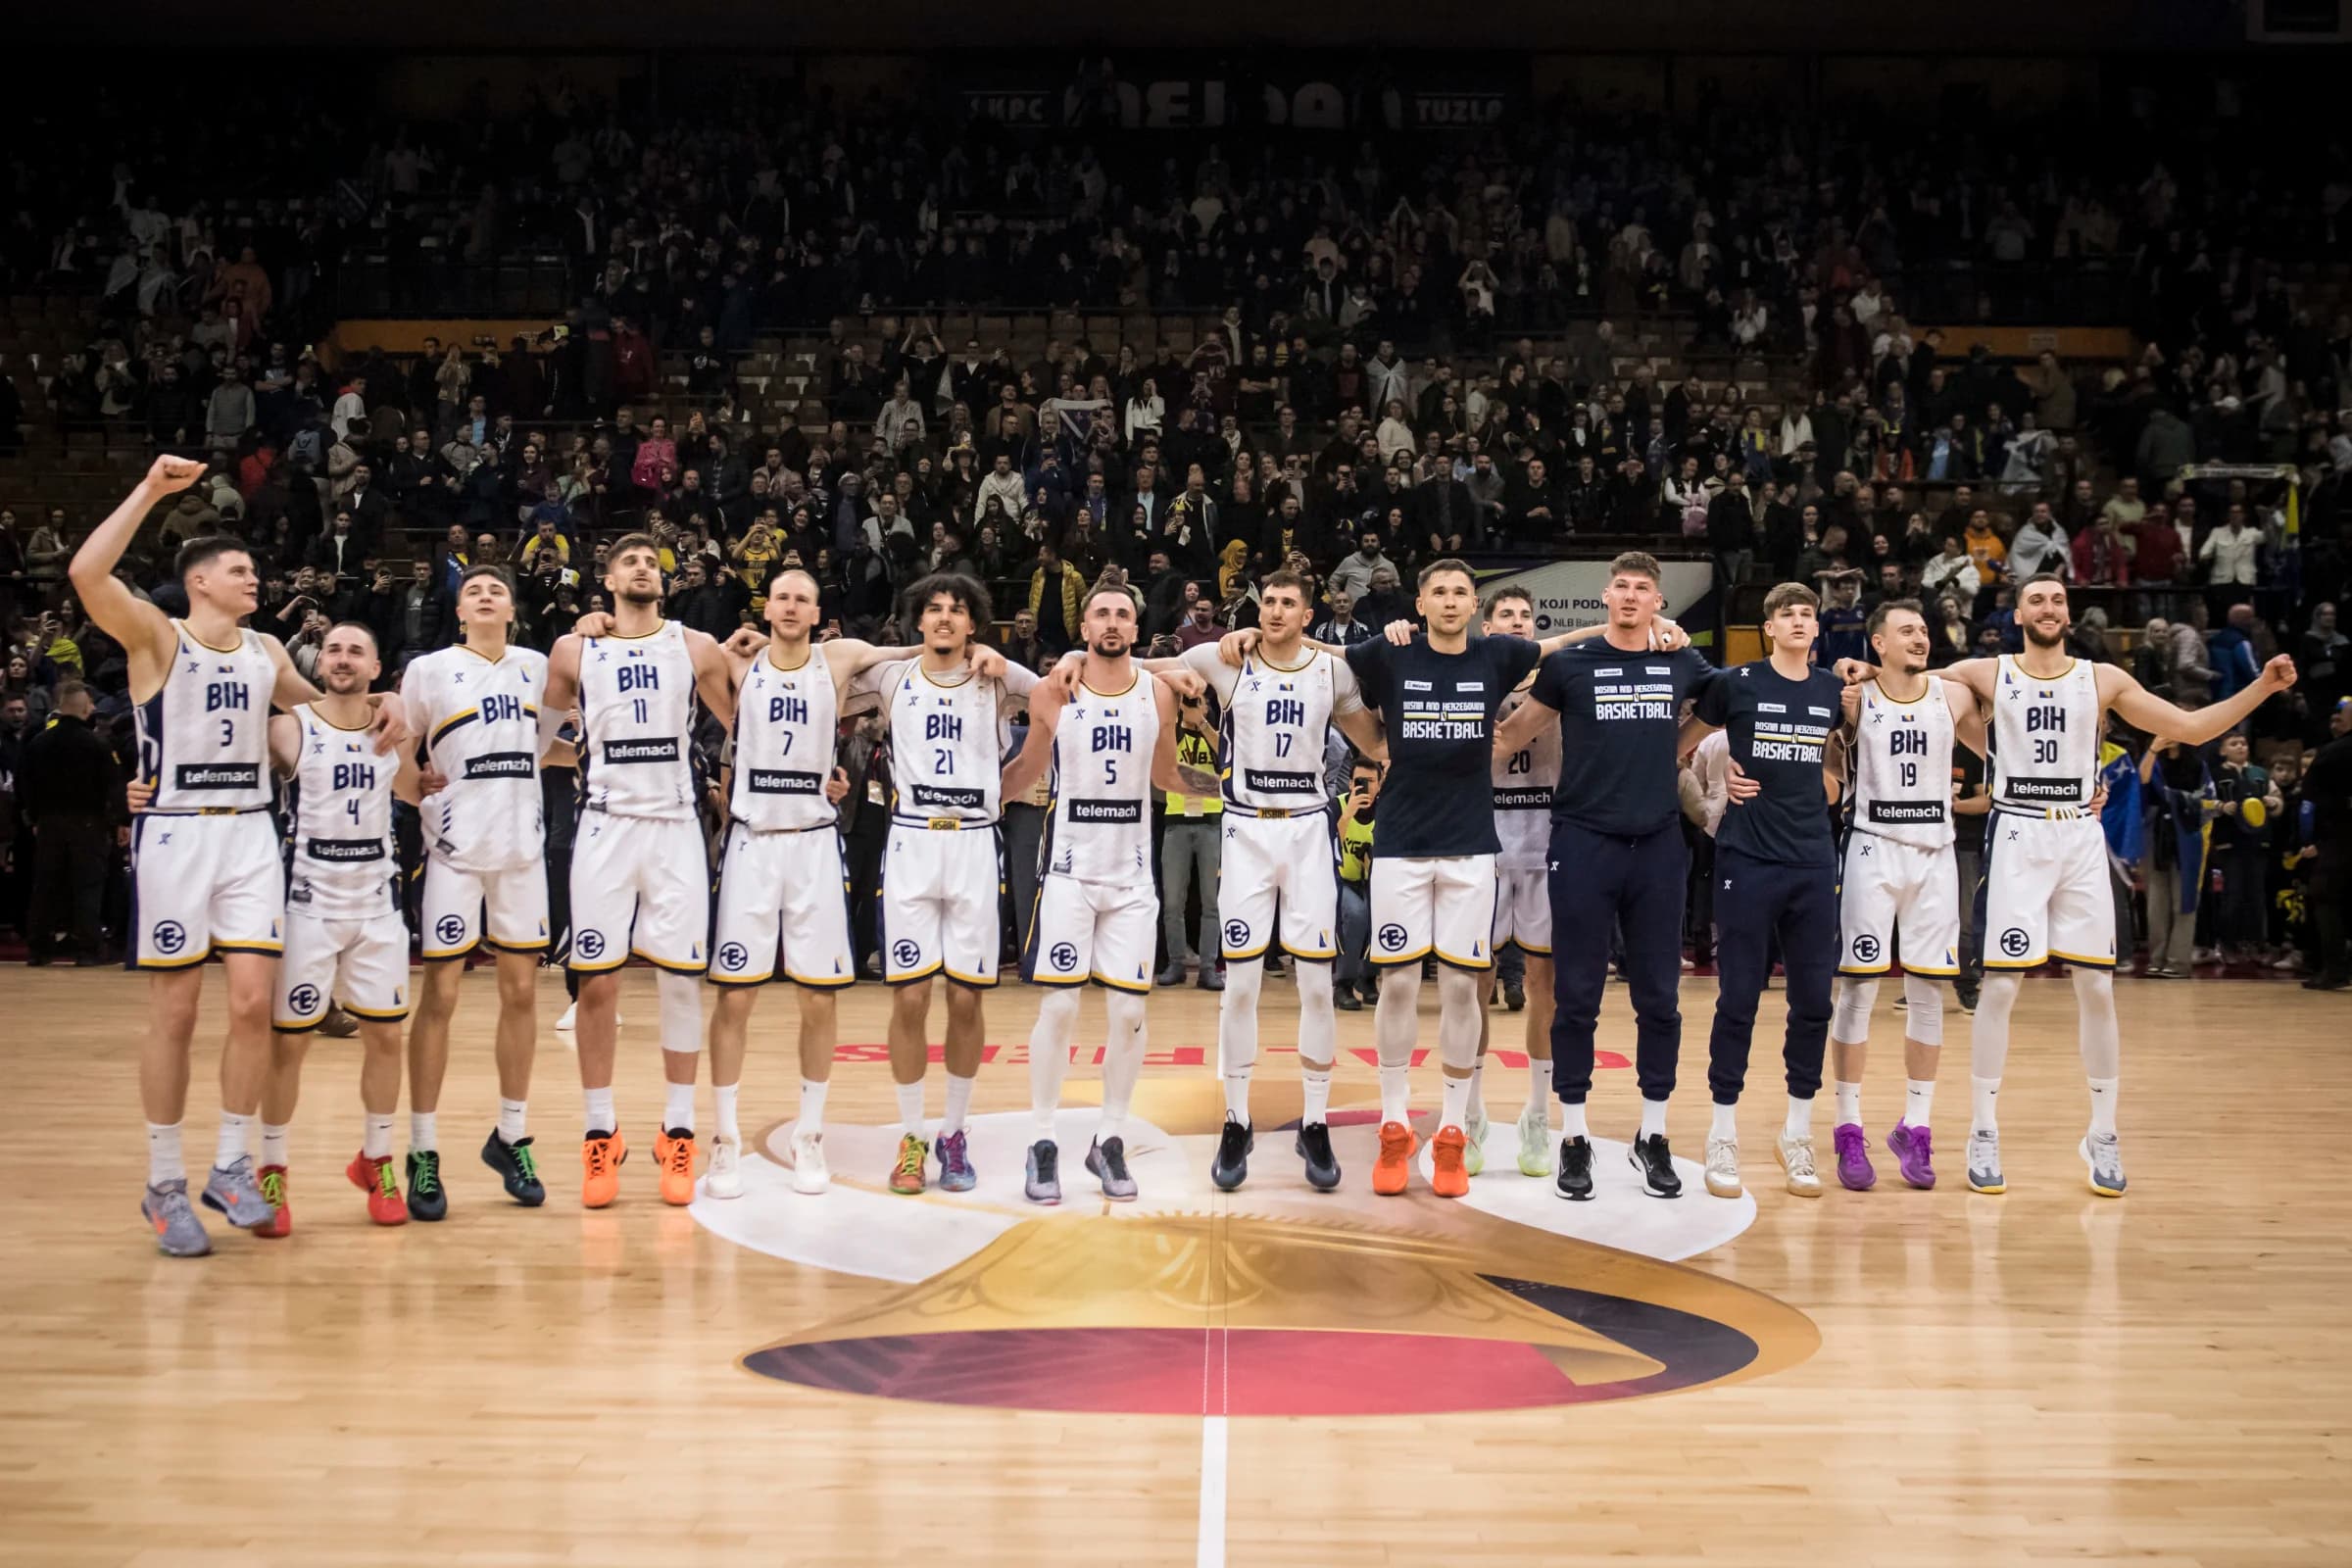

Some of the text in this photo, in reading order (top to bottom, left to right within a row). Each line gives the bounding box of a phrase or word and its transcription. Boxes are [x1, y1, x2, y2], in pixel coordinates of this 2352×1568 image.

[1540, 599, 1568, 610] KOJI
[617, 664, 659, 693] BIH
[206, 681, 249, 711] BIH
[1426, 702, 1440, 711] AND
[481, 694, 520, 725] BIH
[633, 699, 647, 723] 11
[769, 697, 808, 725] BIH
[1266, 699, 1304, 727] BIH
[1595, 702, 1673, 720] BASKETBALL
[2027, 706, 2065, 733] BIH
[220, 719, 233, 747] 3
[925, 713, 962, 742] BIH
[1092, 725, 1132, 753] BIH
[1402, 721, 1484, 739] BASKETBALL
[1780, 723, 1792, 733] AND
[609, 743, 675, 758] telemach
[782, 730, 793, 756] 7
[1275, 733, 1292, 758] 17
[1890, 729, 1927, 757] BIH
[2034, 739, 2058, 763] 30
[935, 749, 954, 775] 21
[1105, 760, 1116, 785] 5
[1508, 750, 1531, 774] 20
[1900, 762, 1917, 787] 19
[333, 762, 374, 791] BIH
[1251, 775, 1314, 789] telemach
[2013, 782, 2078, 796] telemach
[1494, 792, 1550, 804] elemach
[347, 799, 360, 825] 4
[1076, 805, 1137, 817] telemach
[1877, 806, 1940, 817] telemach
